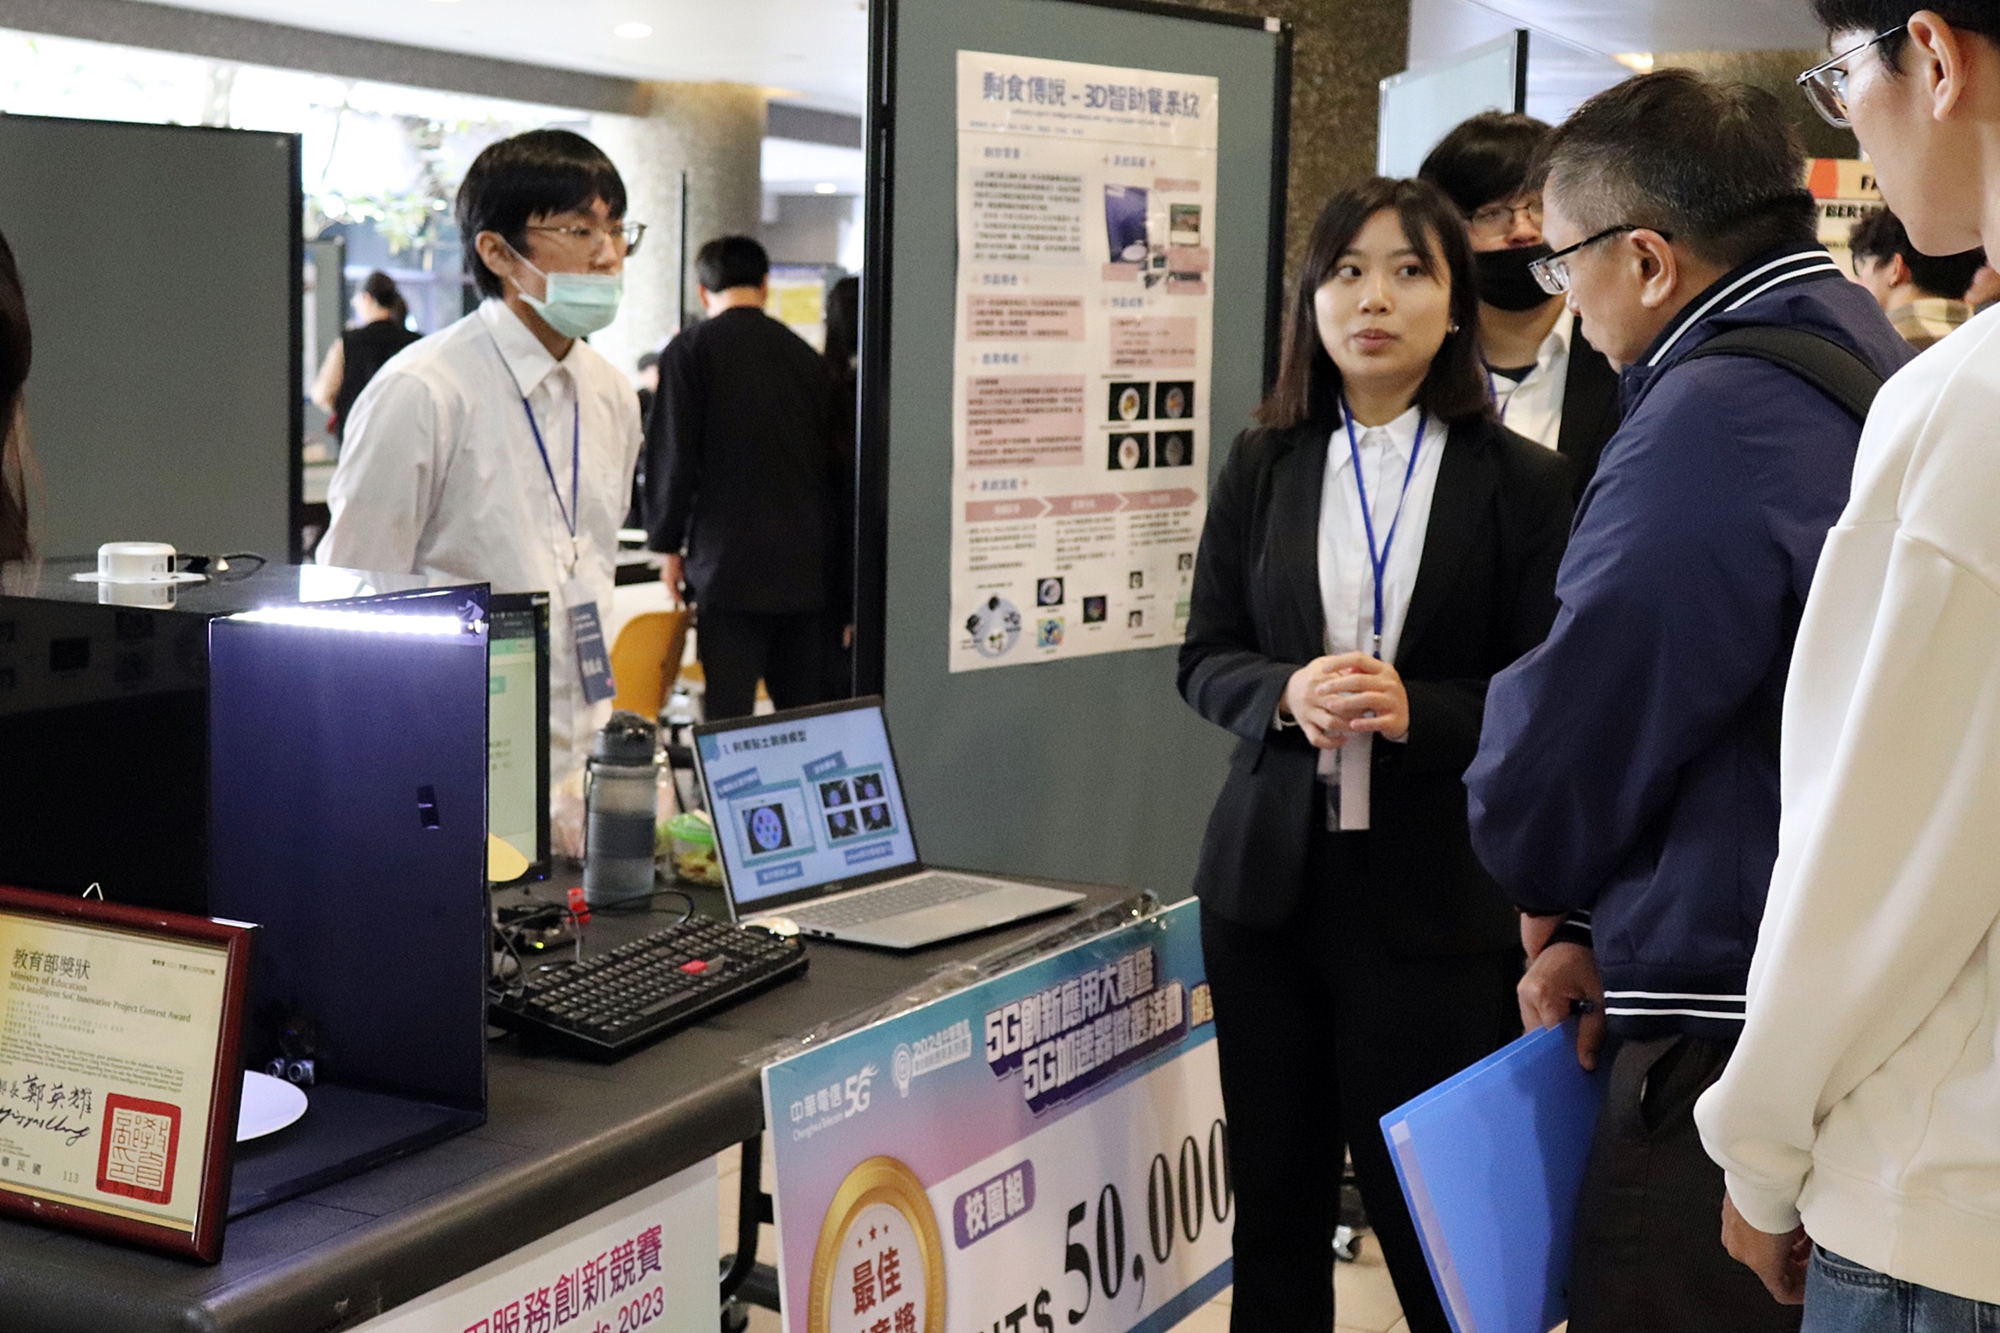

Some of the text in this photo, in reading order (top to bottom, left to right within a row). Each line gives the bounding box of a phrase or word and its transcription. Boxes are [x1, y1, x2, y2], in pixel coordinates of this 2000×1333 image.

[10, 970, 88, 992] Ministry of Education
[12, 948, 91, 980] 教育部獎狀
[8, 981, 191, 1023] 2024 Intelligent SoC Innovative Project Contest Award
[790, 1065, 878, 1124] 中華電信 5G
[62, 1171, 80, 1183] 113
[964, 1168, 1027, 1241] 校園組
[852, 1246, 903, 1316] 最佳
[617, 1286, 664, 1333] 2023
